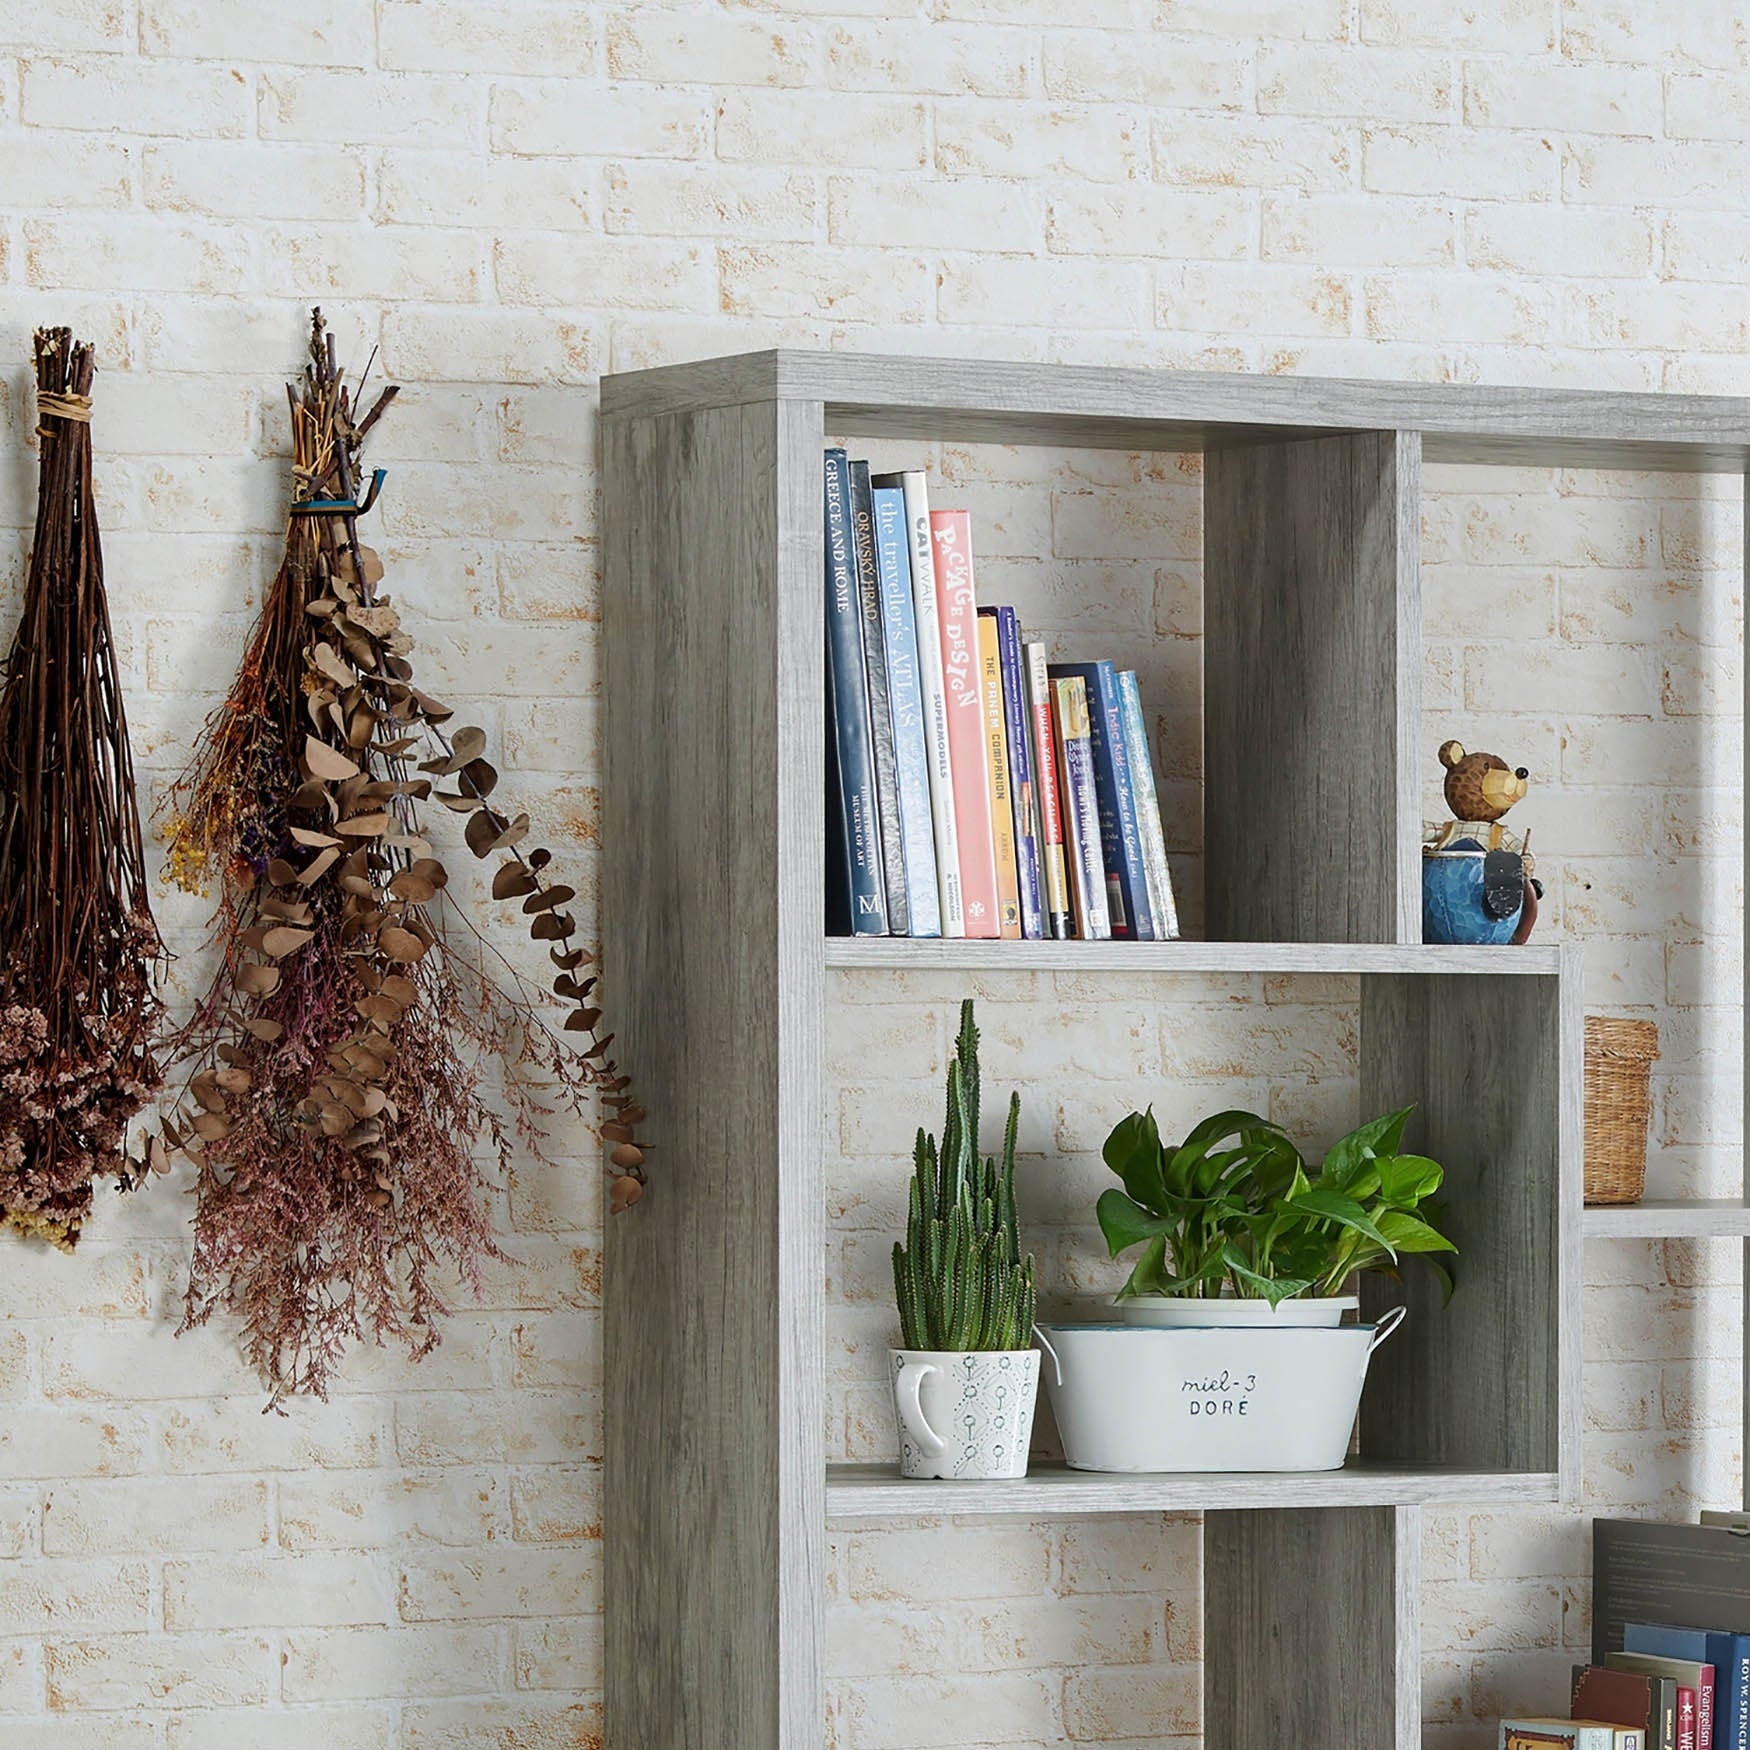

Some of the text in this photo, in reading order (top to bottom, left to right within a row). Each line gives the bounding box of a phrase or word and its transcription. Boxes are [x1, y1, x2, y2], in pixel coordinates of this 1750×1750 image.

[825, 460, 849, 613] GREECE AND ROME
[862, 580, 877, 620] HRAD
[880, 501, 914, 727] the traveller's ATLAS
[934, 524, 980, 708] PACKAGE DESIGN
[916, 517, 933, 616] CATWALK
[933, 693, 948, 779] SUPERMODELS
[985, 656, 995, 676] THE
[1741, 1658, 1750, 1682] ROY
[1741, 1685, 1749, 1697] W.
[1700, 1685, 1713, 1746] Evangelism
